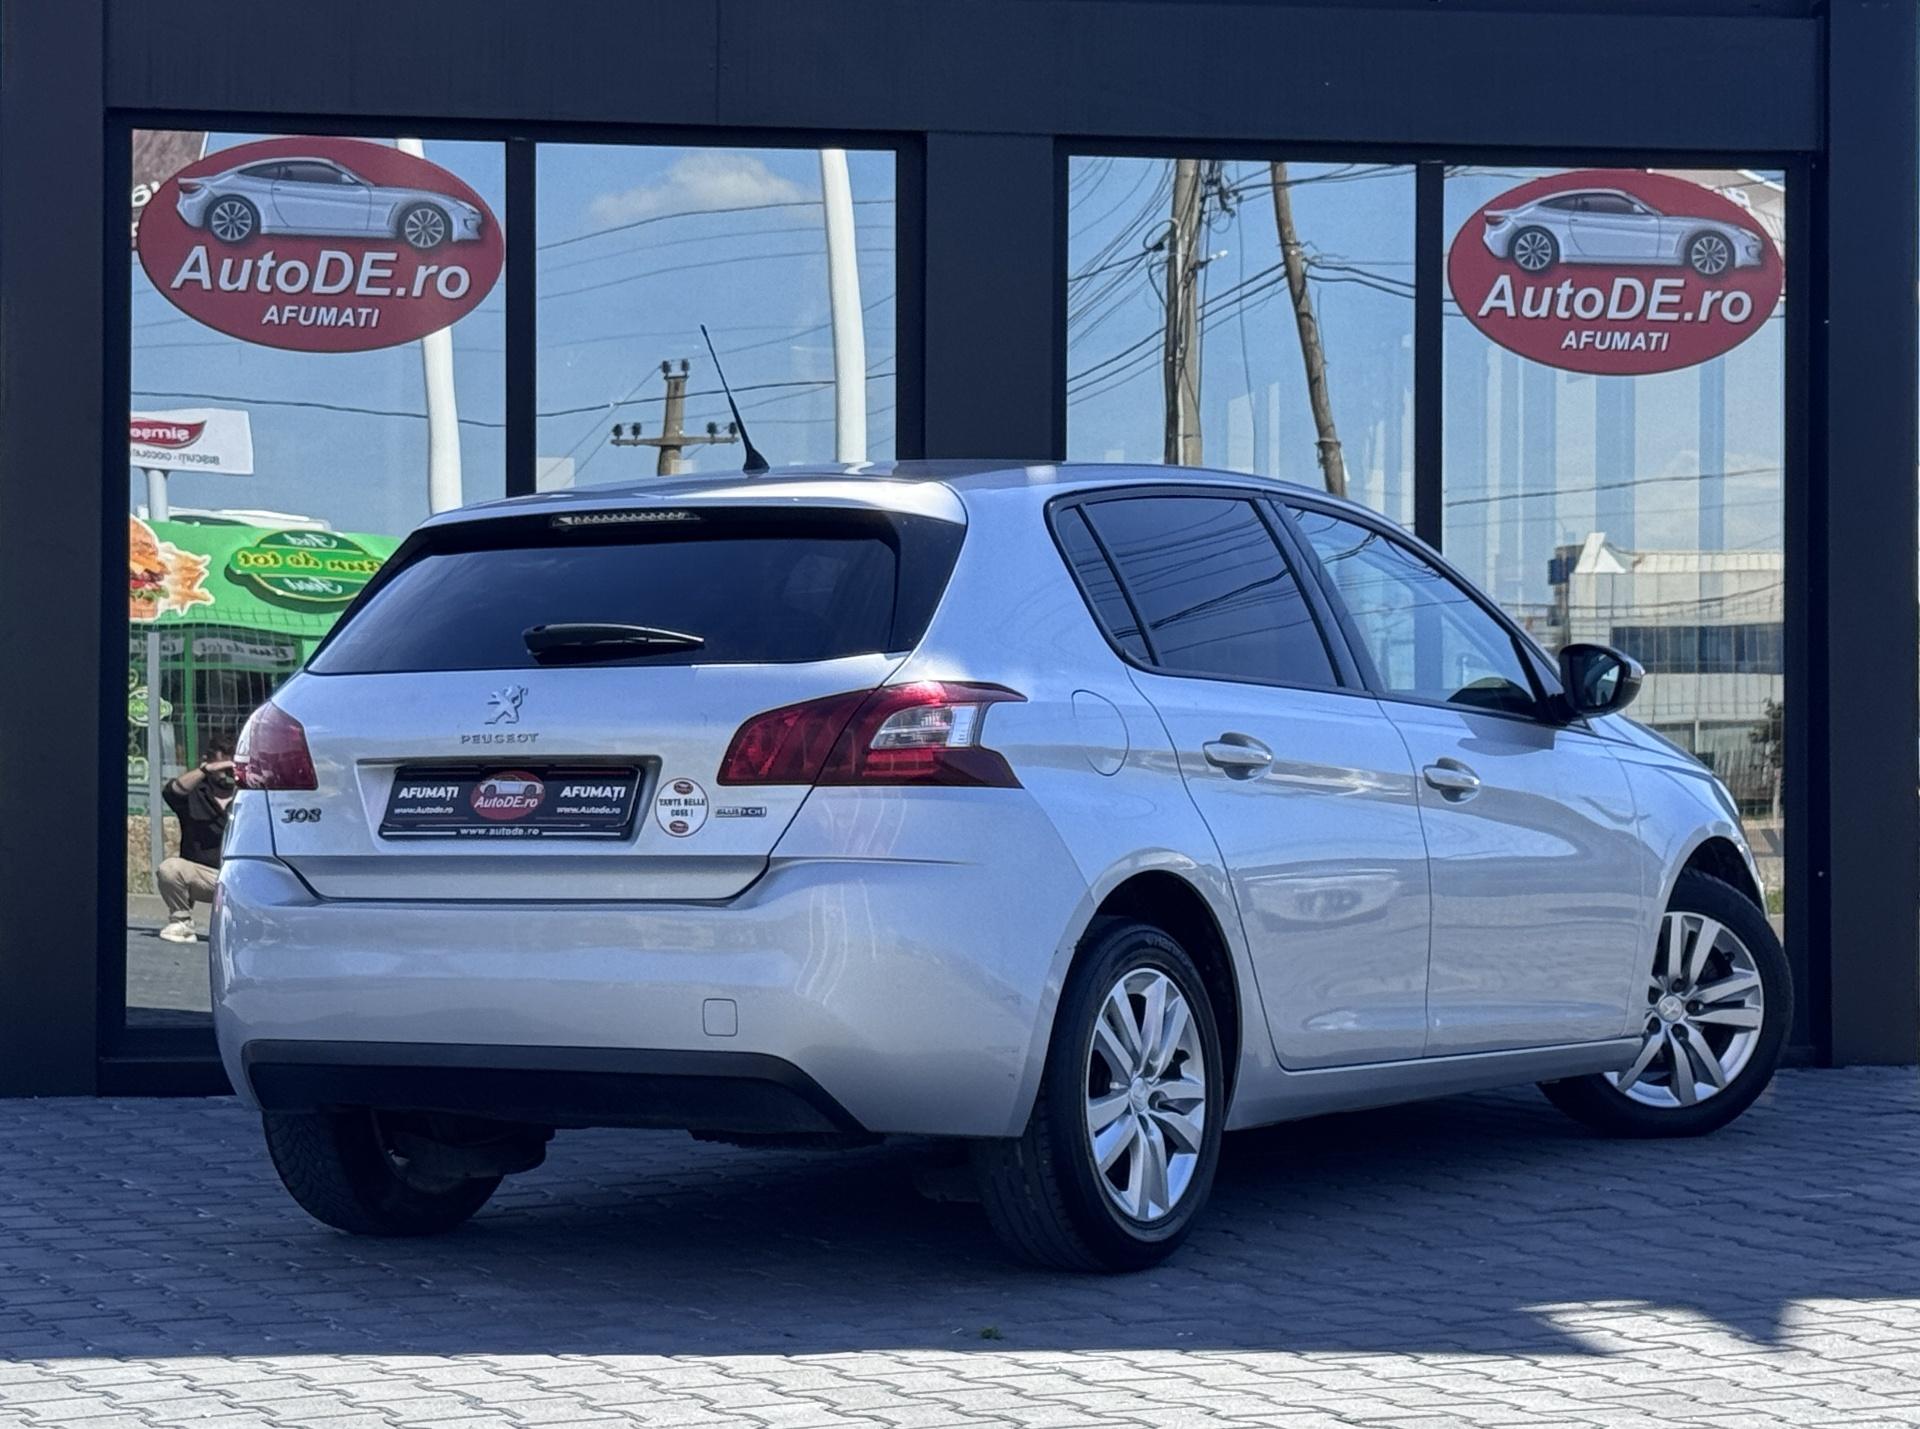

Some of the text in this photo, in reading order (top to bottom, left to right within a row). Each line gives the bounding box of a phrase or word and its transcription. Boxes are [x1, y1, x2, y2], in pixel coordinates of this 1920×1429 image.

[171, 245, 471, 299] AutoDE.ro
[1478, 274, 1753, 323] AutoDE.ro
[261, 305, 380, 328] AFUMATI
[1560, 331, 1670, 352] AFUMATI
[461, 733, 539, 744] PEUGEOT
[473, 796, 538, 809] AutoDE.ro
[281, 808, 322, 823] 308
[460, 828, 540, 836] www.autode.ro
